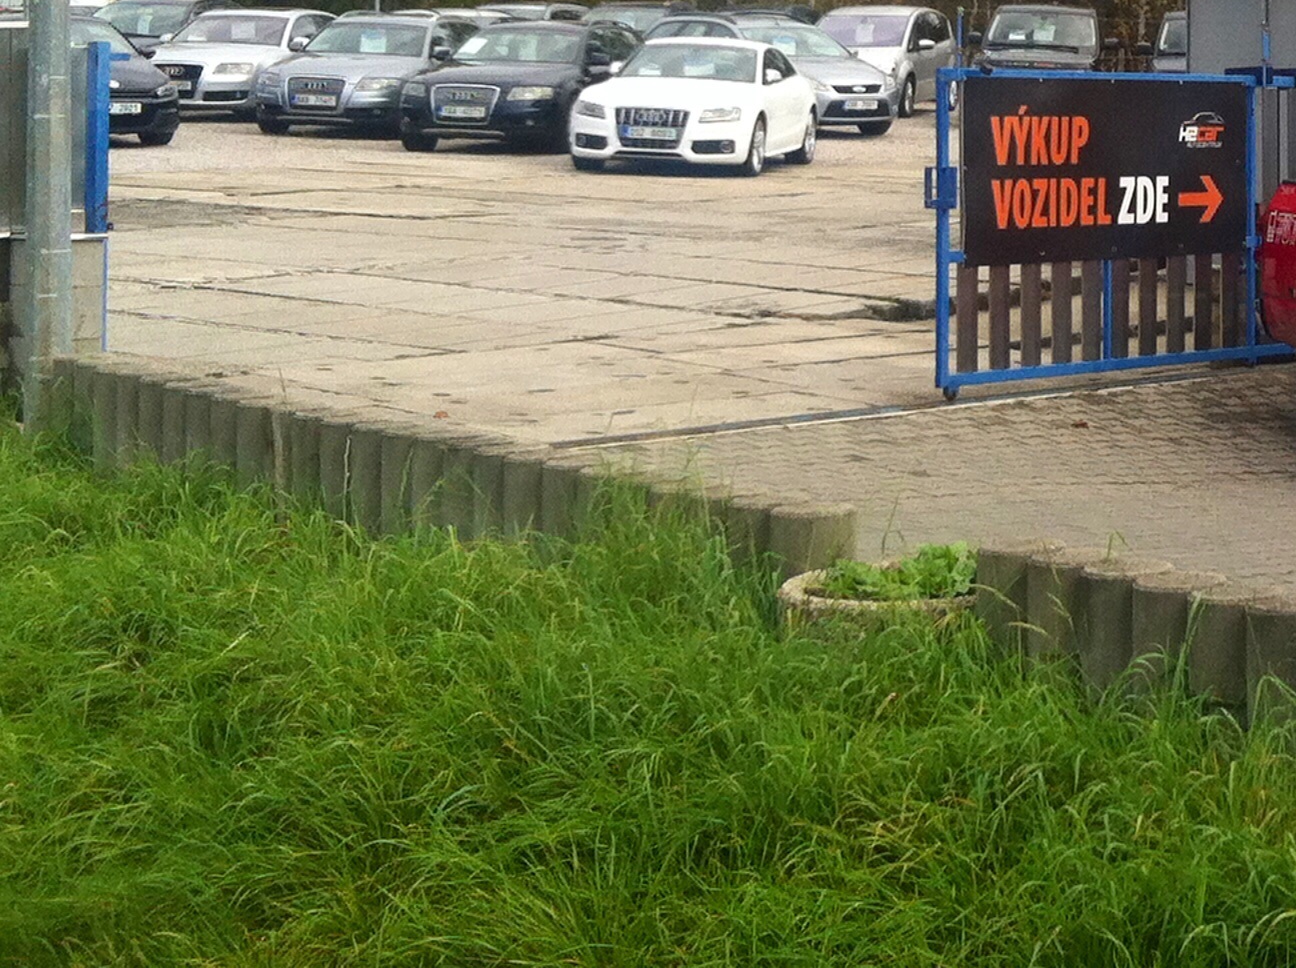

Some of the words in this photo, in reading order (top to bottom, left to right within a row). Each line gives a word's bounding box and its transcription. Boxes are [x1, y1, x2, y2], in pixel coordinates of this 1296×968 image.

[991, 105, 1091, 166] VÝKUP
[992, 177, 1112, 230] VOZIDEL
[1117, 175, 1170, 225] ZDE
